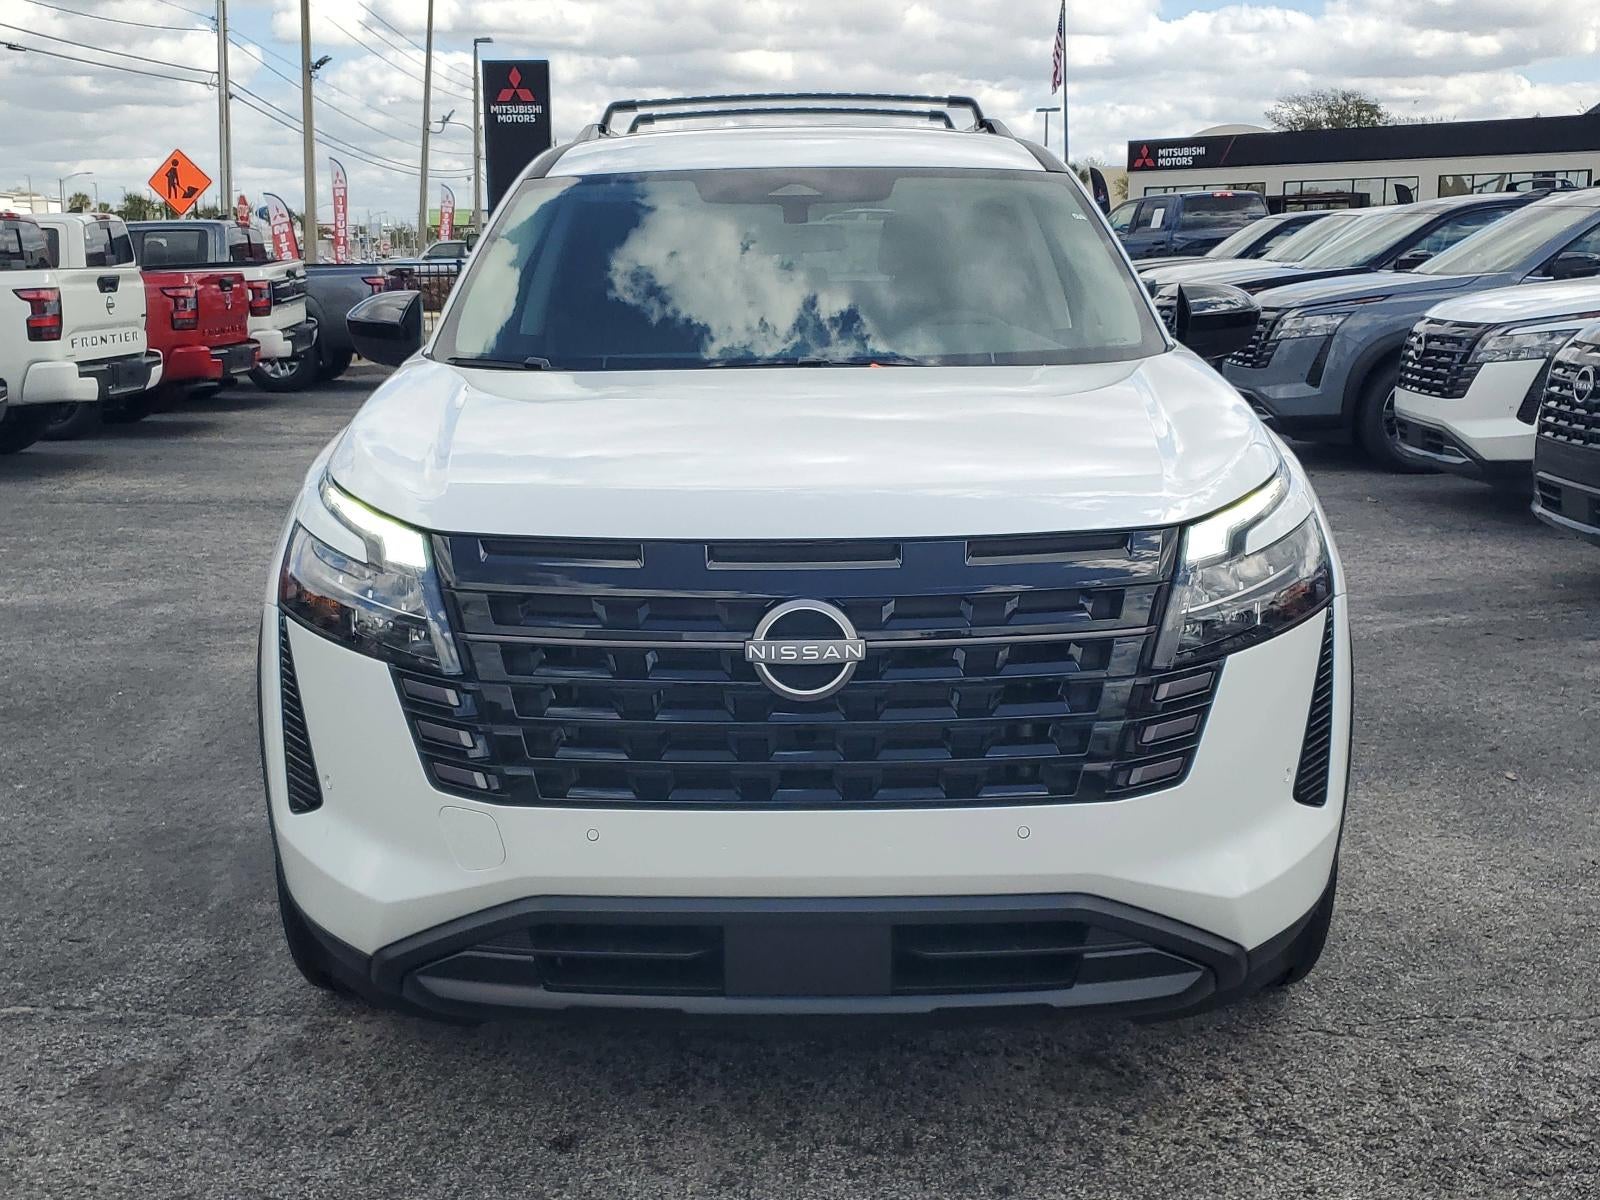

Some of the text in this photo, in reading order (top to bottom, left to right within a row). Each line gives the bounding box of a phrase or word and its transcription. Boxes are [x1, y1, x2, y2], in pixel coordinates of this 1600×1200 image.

[490, 105, 542, 114] MITSUBISHI
[497, 115, 536, 123] MOTORS
[1158, 146, 1206, 157] MITSUBISHI
[1157, 157, 1193, 167] MOTORS
[335, 188, 346, 263] MITSUBISH
[71, 331, 139, 349] FRONTIER
[748, 643, 862, 660] NISSAN
